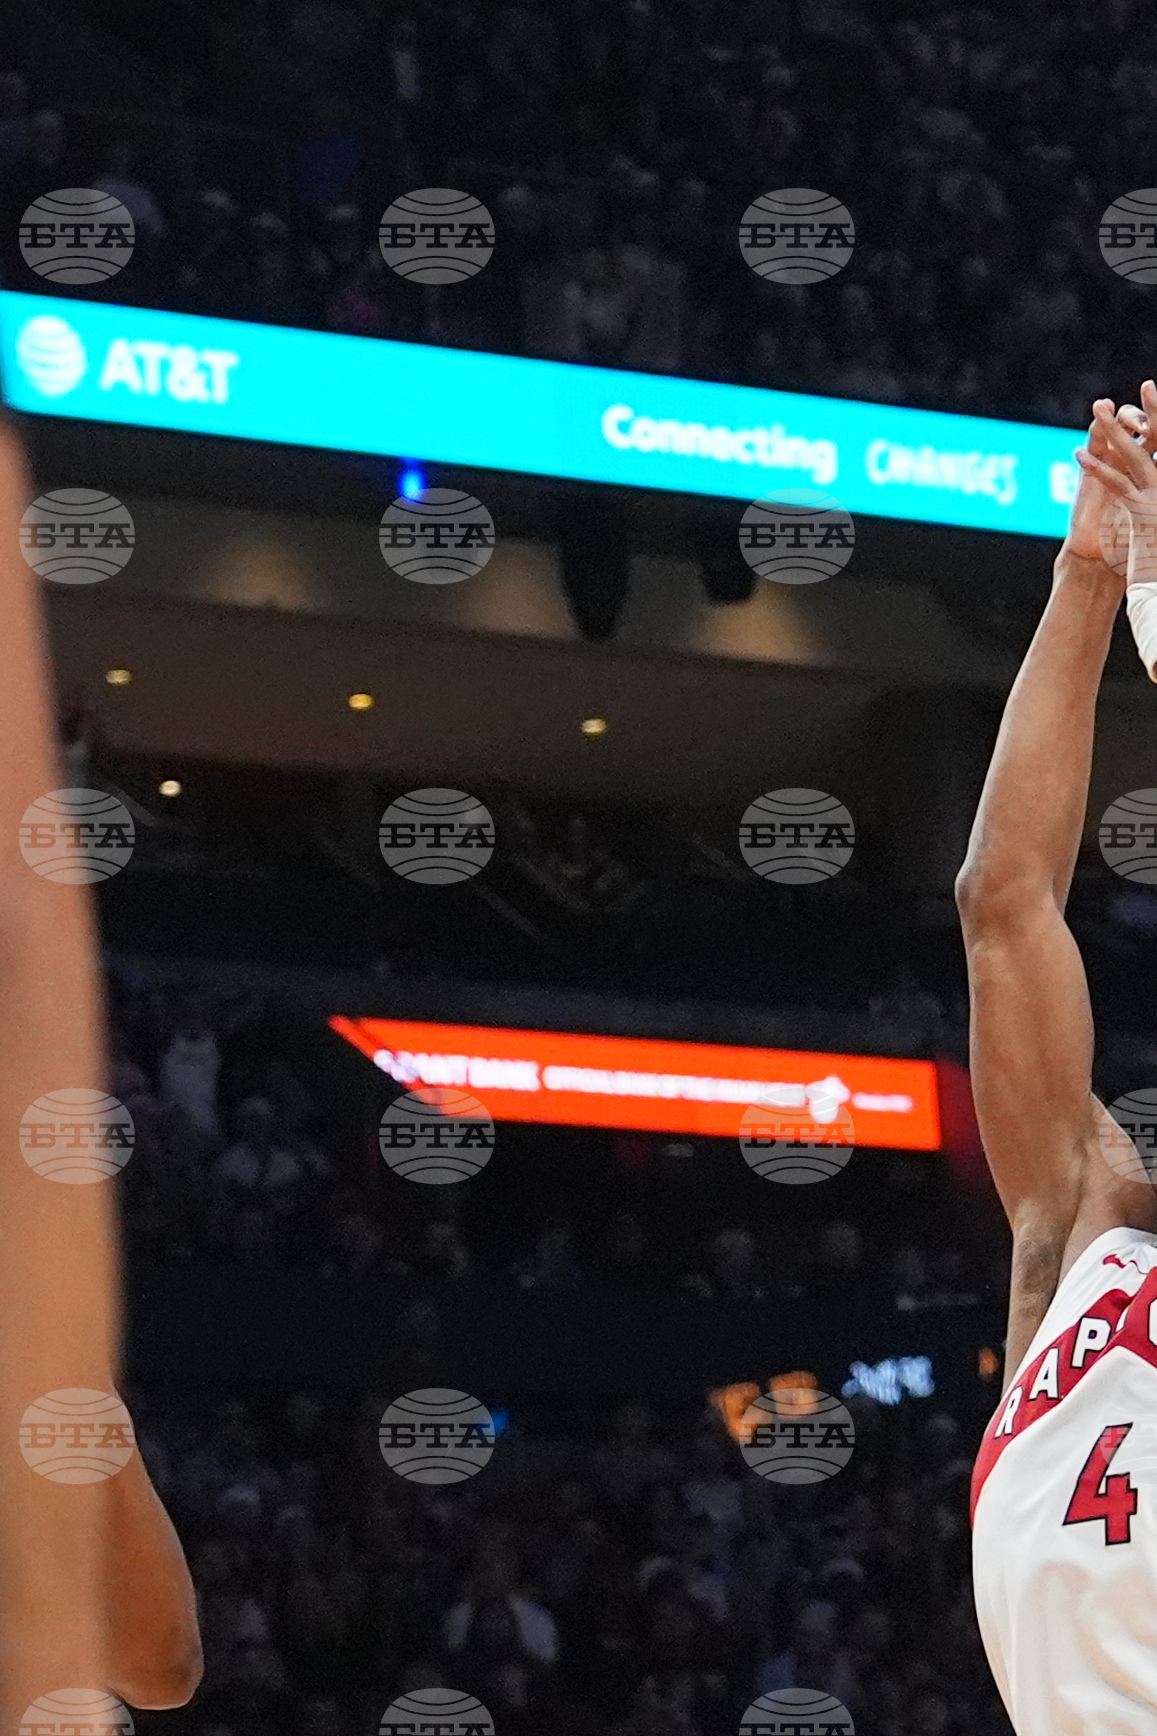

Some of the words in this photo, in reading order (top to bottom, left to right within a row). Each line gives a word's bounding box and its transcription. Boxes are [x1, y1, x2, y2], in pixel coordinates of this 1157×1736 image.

[99, 339, 239, 404] AT&T
[601, 404, 838, 485] Connecting
[1061, 1421, 1139, 1547] 4
